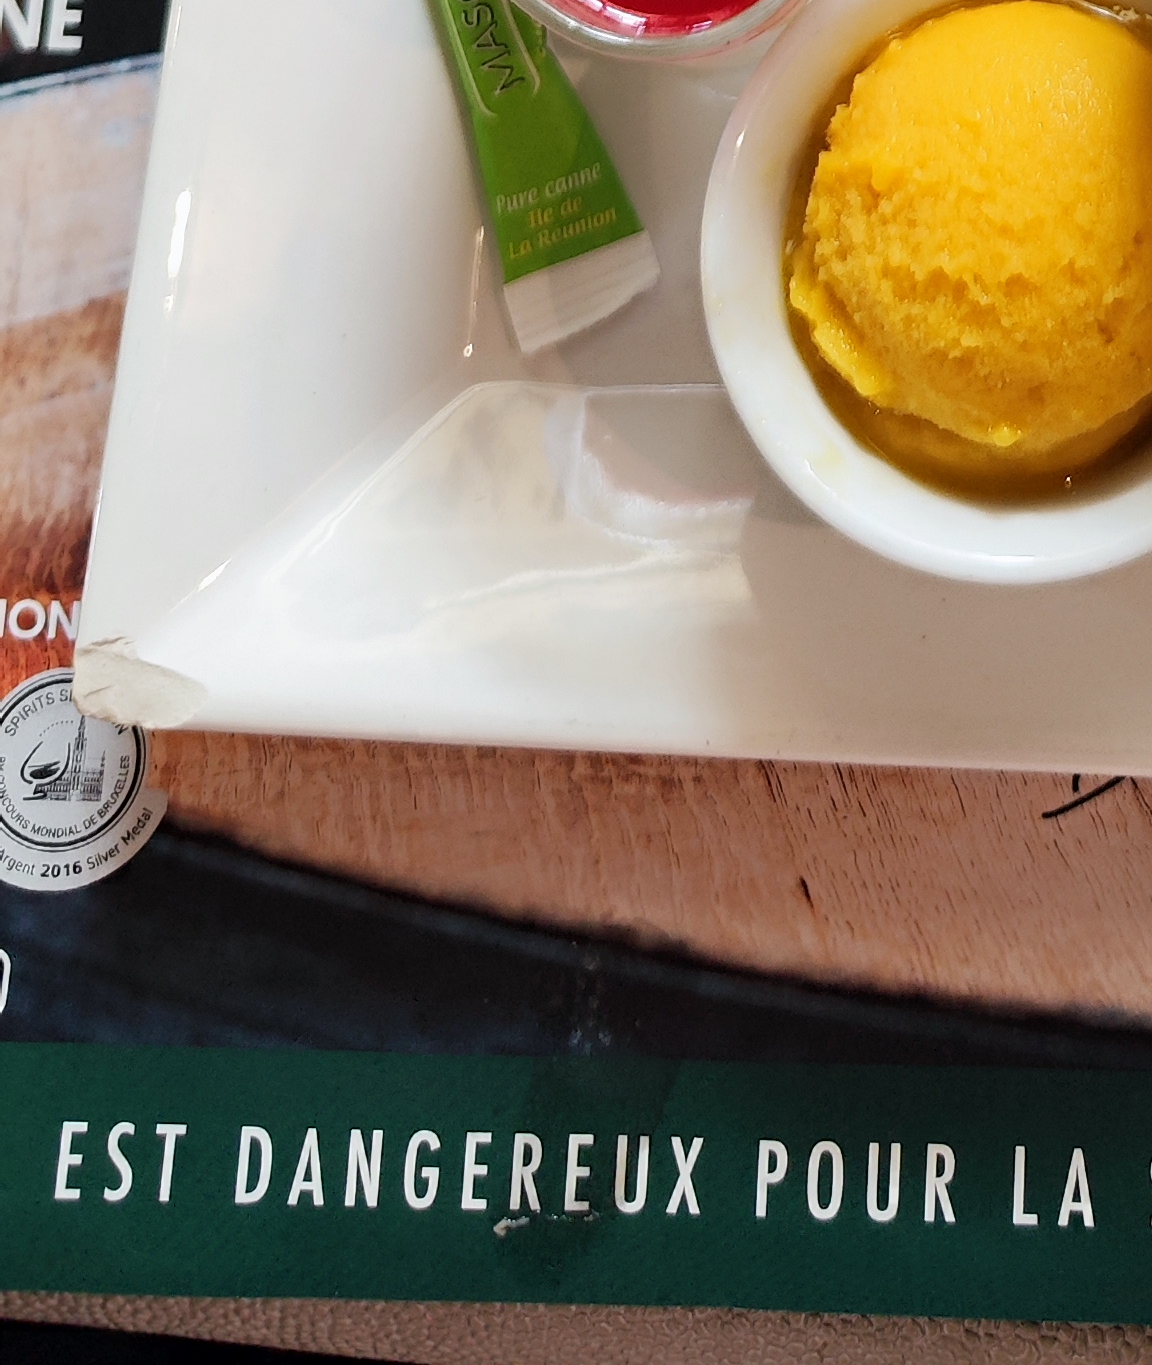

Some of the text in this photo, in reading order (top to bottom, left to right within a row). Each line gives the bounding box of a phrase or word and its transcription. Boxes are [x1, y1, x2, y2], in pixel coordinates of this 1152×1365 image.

[496, 161, 600, 214] Pure canne
[560, 196, 583, 216] de
[508, 238, 532, 260] La
[4, 689, 55, 737] SPIRITS
[30, 824, 82, 839] MONDIAL
[84, 816, 98, 830] DE
[97, 754, 130, 818] BRUXELLES
[40, 861, 83, 878] 2016
[87, 842, 120, 871] Silver
[121, 807, 154, 847] Medal
[54, 1121, 187, 1202] EST
[235, 1126, 703, 1215] DANGEREUX
[756, 1140, 955, 1223] POUR
[1013, 1146, 1094, 1227] LA
